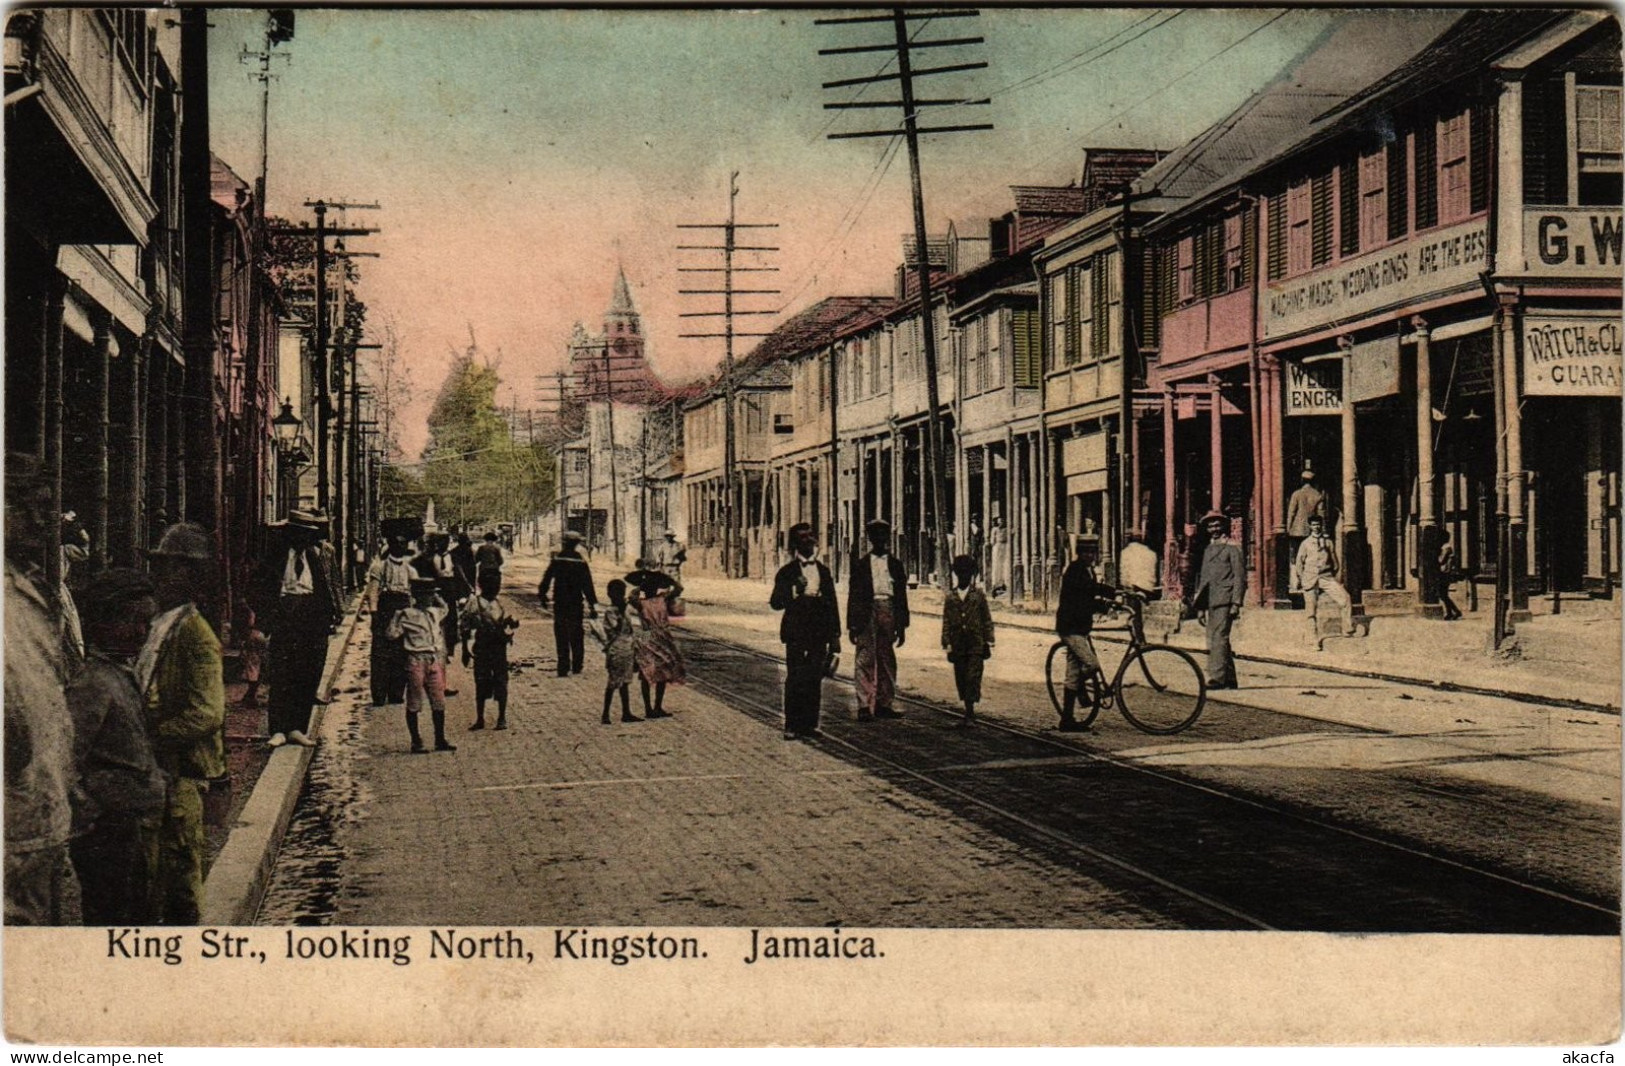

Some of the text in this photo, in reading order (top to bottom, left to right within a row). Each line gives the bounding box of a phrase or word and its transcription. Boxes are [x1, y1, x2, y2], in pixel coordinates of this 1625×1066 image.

[1341, 262, 1379, 298] WEDDING
[1382, 251, 1408, 287] RINGS
[1419, 244, 1437, 275] ARE
[1442, 237, 1460, 269] THE
[1551, 365, 1622, 386] GUARA
